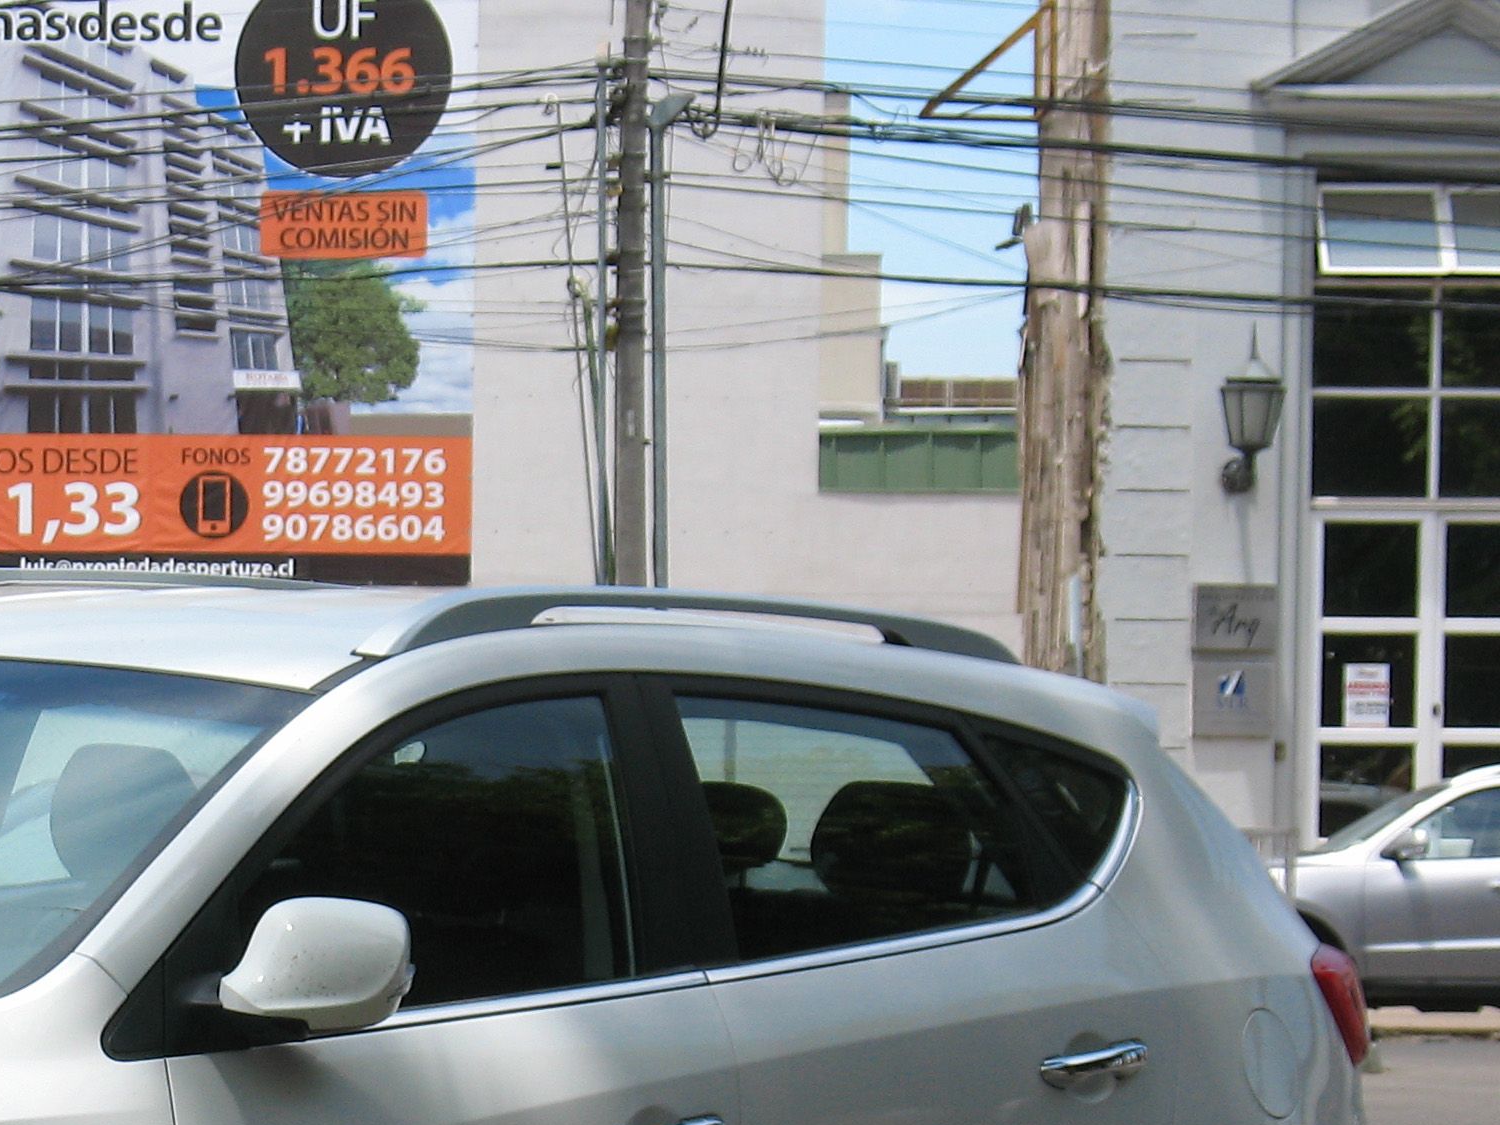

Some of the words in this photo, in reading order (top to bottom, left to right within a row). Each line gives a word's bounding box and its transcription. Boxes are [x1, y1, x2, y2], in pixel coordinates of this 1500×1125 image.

[79, 0, 223, 41] desde
[313, 0, 377, 40] UF
[263, 46, 417, 95] 1.366
[319, 105, 393, 145] IVA
[274, 199, 370, 223] VENTAS
[377, 200, 418, 223] SIN
[279, 222, 410, 250] COMISIÓN
[42, 447, 138, 474] DESDE
[181, 447, 251, 466] FONOS
[263, 446, 447, 475] 78772176
[262, 480, 445, 508] 99698493
[262, 513, 446, 542] 90786604
